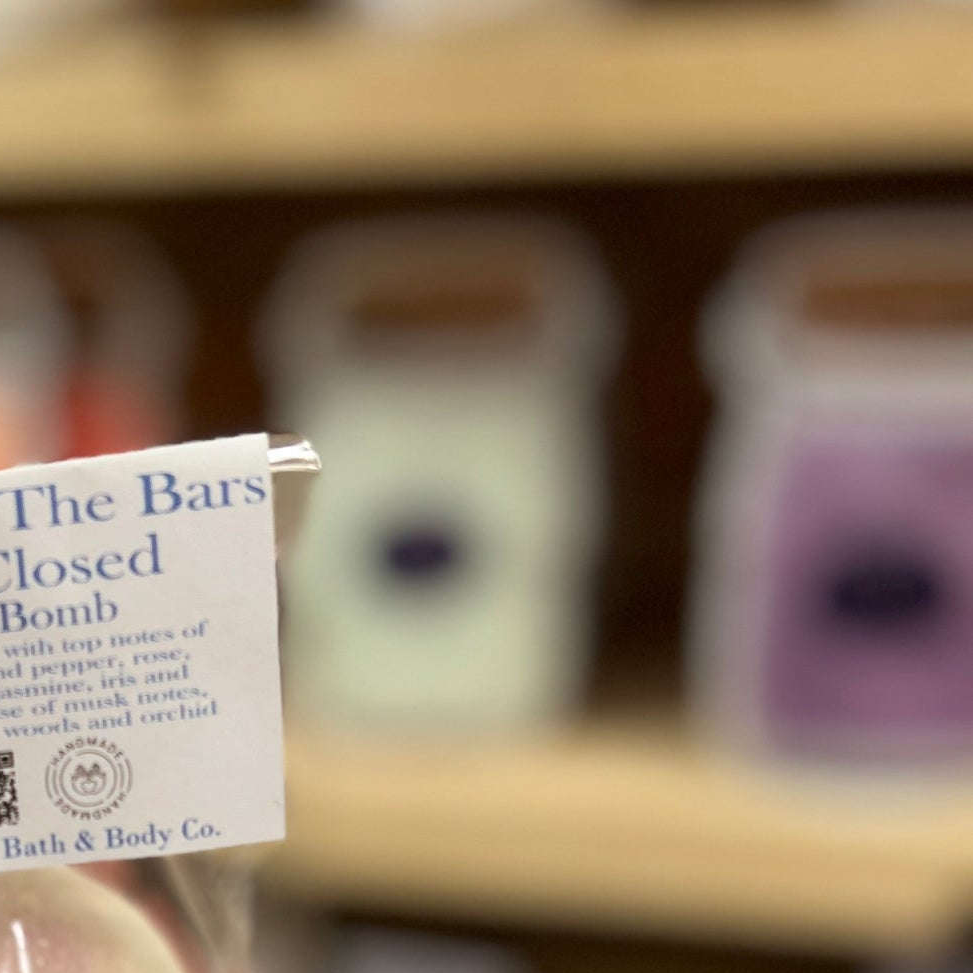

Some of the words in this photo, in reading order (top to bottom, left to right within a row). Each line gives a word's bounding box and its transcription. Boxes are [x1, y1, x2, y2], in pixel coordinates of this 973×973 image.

[137, 471, 267, 517] Bars
[0, 592, 118, 632] Bomb
[4, 638, 53, 657] with
[62, 636, 102, 653] top
[110, 628, 174, 648] notes
[182, 618, 209, 638] of
[31, 655, 124, 679] pepper,
[133, 648, 190, 665] rose,
[101, 672, 136, 689] iris
[144, 663, 188, 684] and
[4, 717, 80, 737] woods
[88, 711, 132, 730] and
[140, 699, 217, 724] orchid
[31, 699, 57, 715] of
[64, 692, 129, 713] musk
[138, 687, 207, 704] notes,
[50, 736, 124, 767] HANDMADE
[3, 832, 66, 859] Bath
[74, 830, 95, 852] &
[105, 822, 171, 850] Body
[181, 817, 221, 841] Co.
